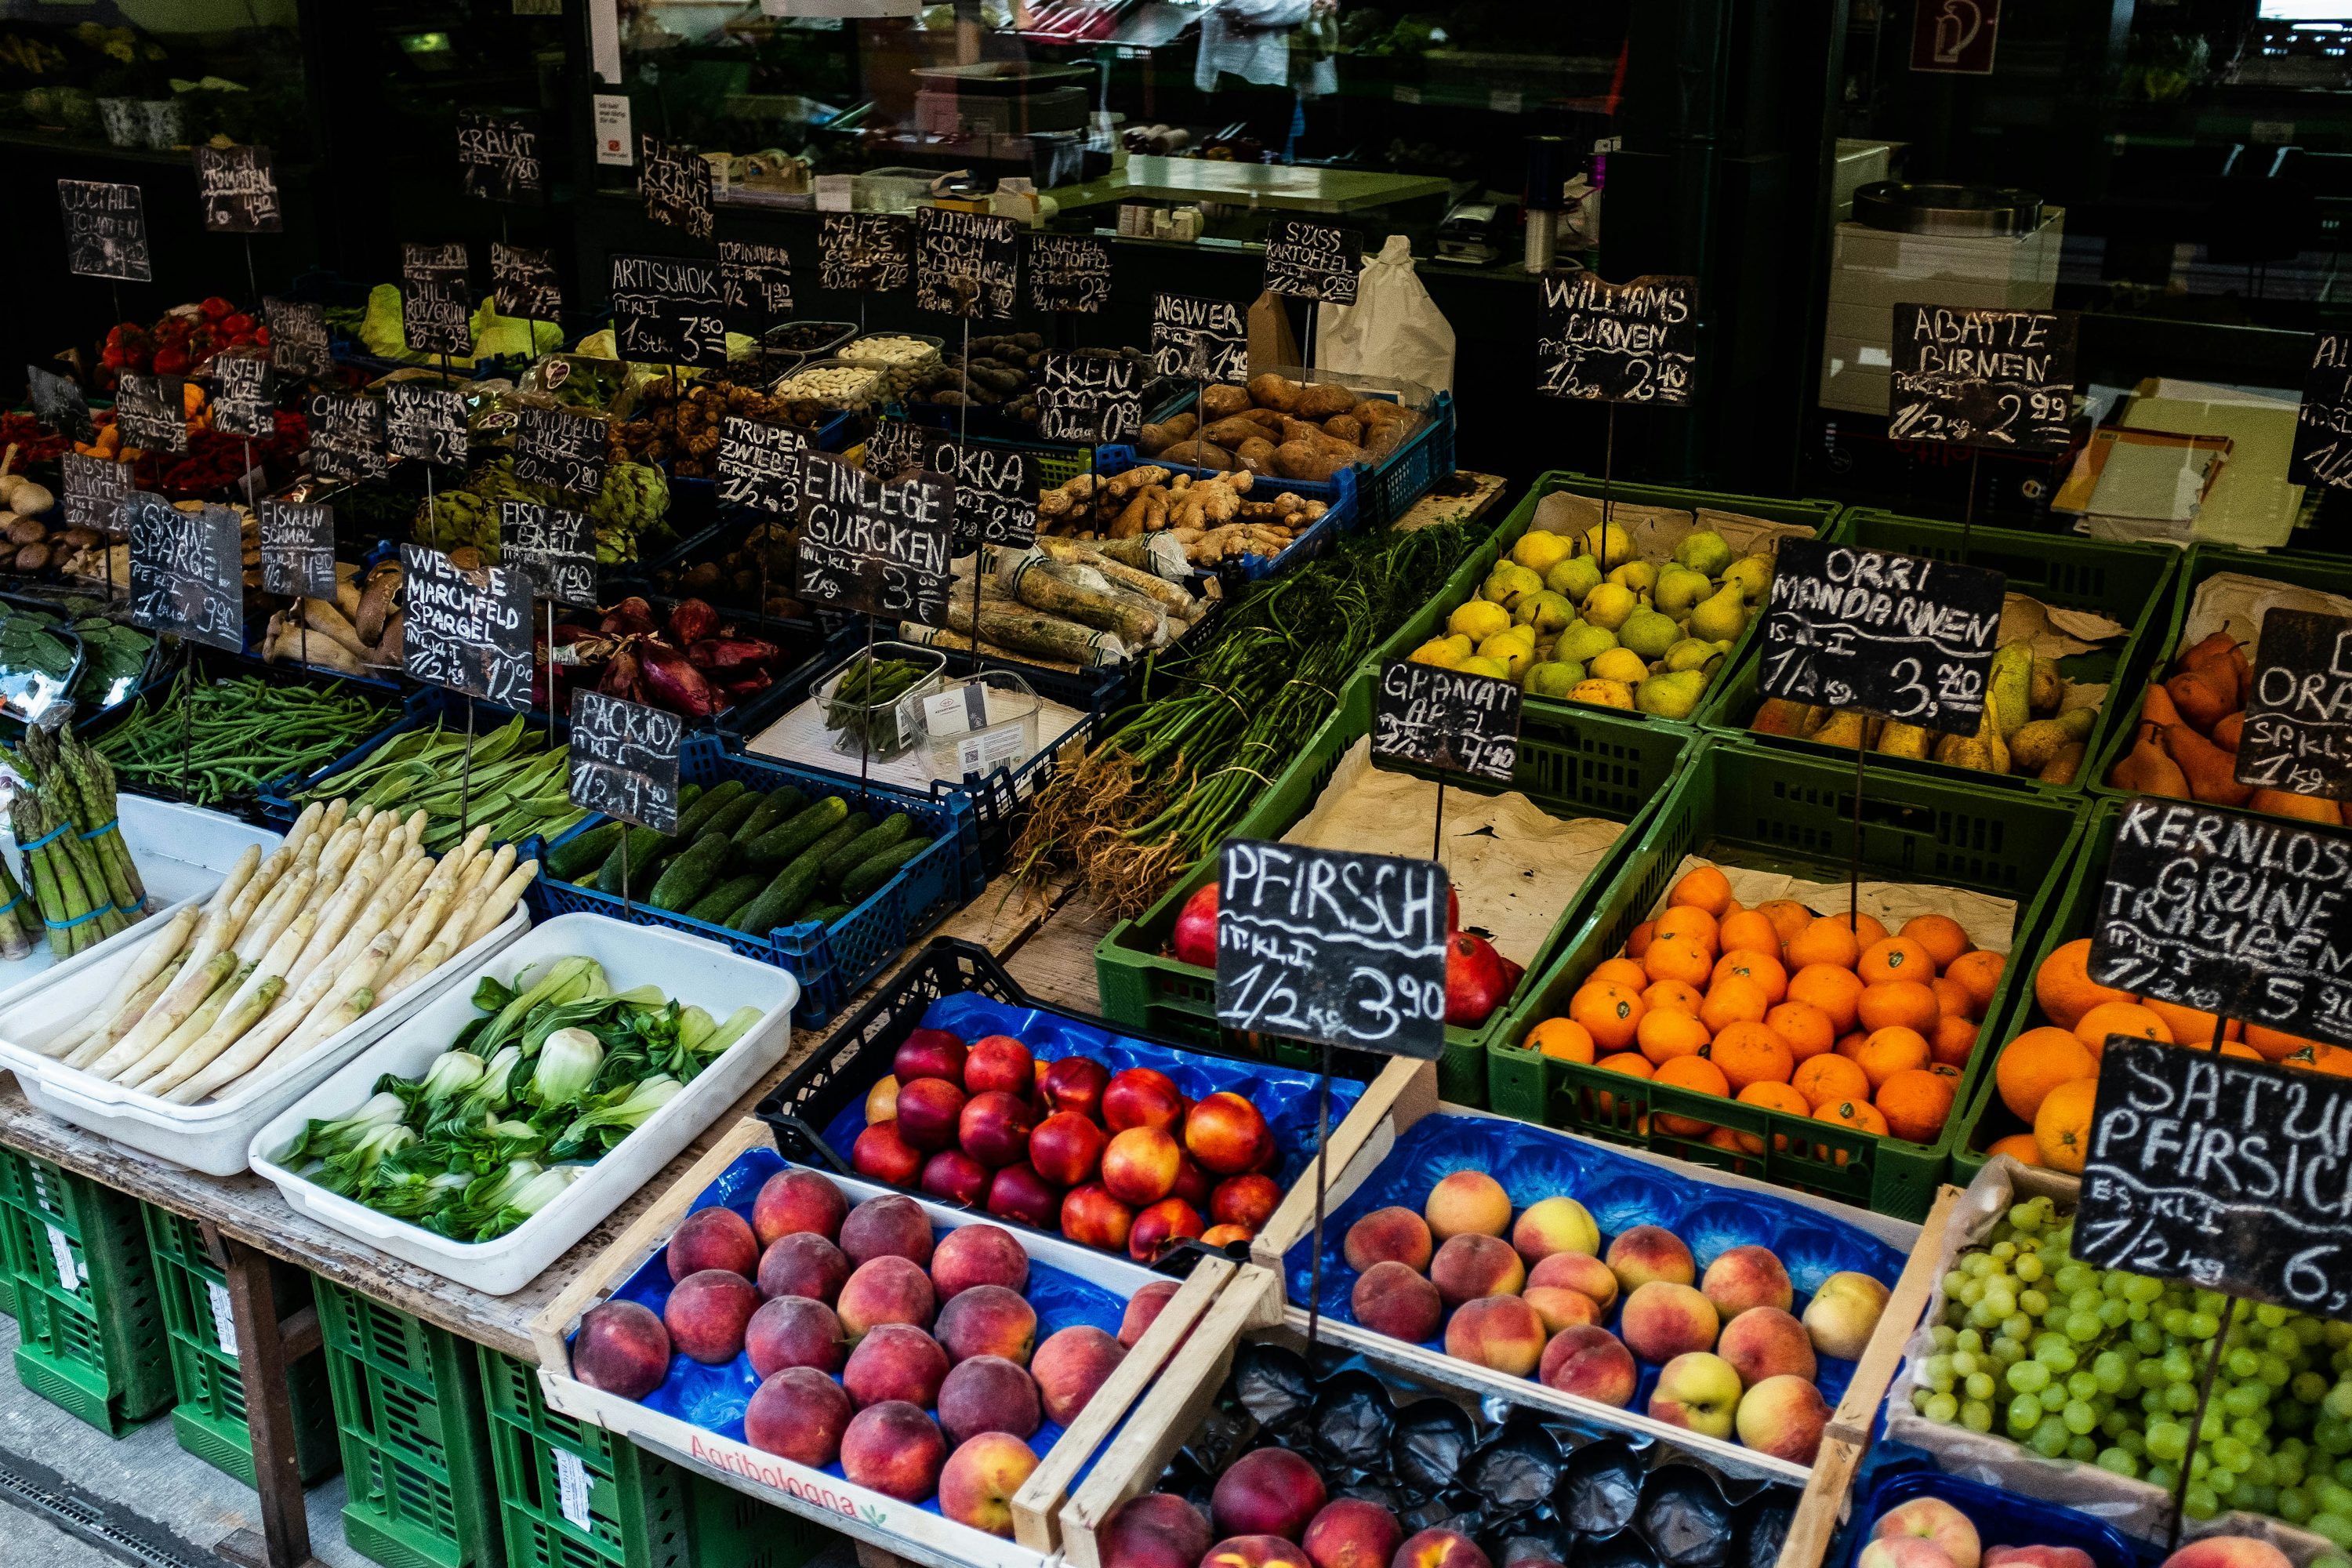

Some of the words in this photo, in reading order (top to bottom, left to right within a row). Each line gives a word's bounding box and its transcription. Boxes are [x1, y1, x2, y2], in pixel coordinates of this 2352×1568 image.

[456, 128, 536, 158] KRAUT
[925, 234, 985, 260] KOCH
[1266, 238, 1354, 274] KARTOFFEL
[1286, 221, 1342, 253] SÜSS
[825, 248, 909, 267] BONEN
[612, 257, 720, 298] ARTISCHOK
[1544, 276, 1690, 324] WILLIAMS
[1564, 313, 1670, 350] BIRNEN
[1913, 307, 2058, 350] ABATTE
[223, 376, 263, 401] PILZE
[1043, 354, 1133, 389] KREN
[536, 427, 583, 453] PILZE
[724, 416, 808, 452] TROPEA
[63, 451, 128, 484] ERBSEN
[719, 436, 800, 477] ZWIEBEL
[935, 441, 1025, 492] OKRA
[801, 453, 944, 525] EINLEGE
[260, 525, 315, 545] SCHMAL
[501, 503, 584, 534] FISOEN
[517, 524, 582, 552] BREIT
[132, 524, 231, 583] SPARGEL
[807, 503, 948, 578] GURCKEN
[1824, 546, 1933, 594] ORRI
[406, 576, 520, 631] MARCHFELD
[409, 599, 496, 645] SPARGEL
[409, 650, 446, 681] 1/2
[1383, 662, 1519, 713] GRANAT
[1406, 697, 1491, 735] APEL
[2115, 800, 2352, 887] KERNLOS
[1223, 843, 1436, 941] PFIRSCH
[1215, 961, 1311, 1030] 1/2
[690, 1432, 859, 1521] Agribologna
